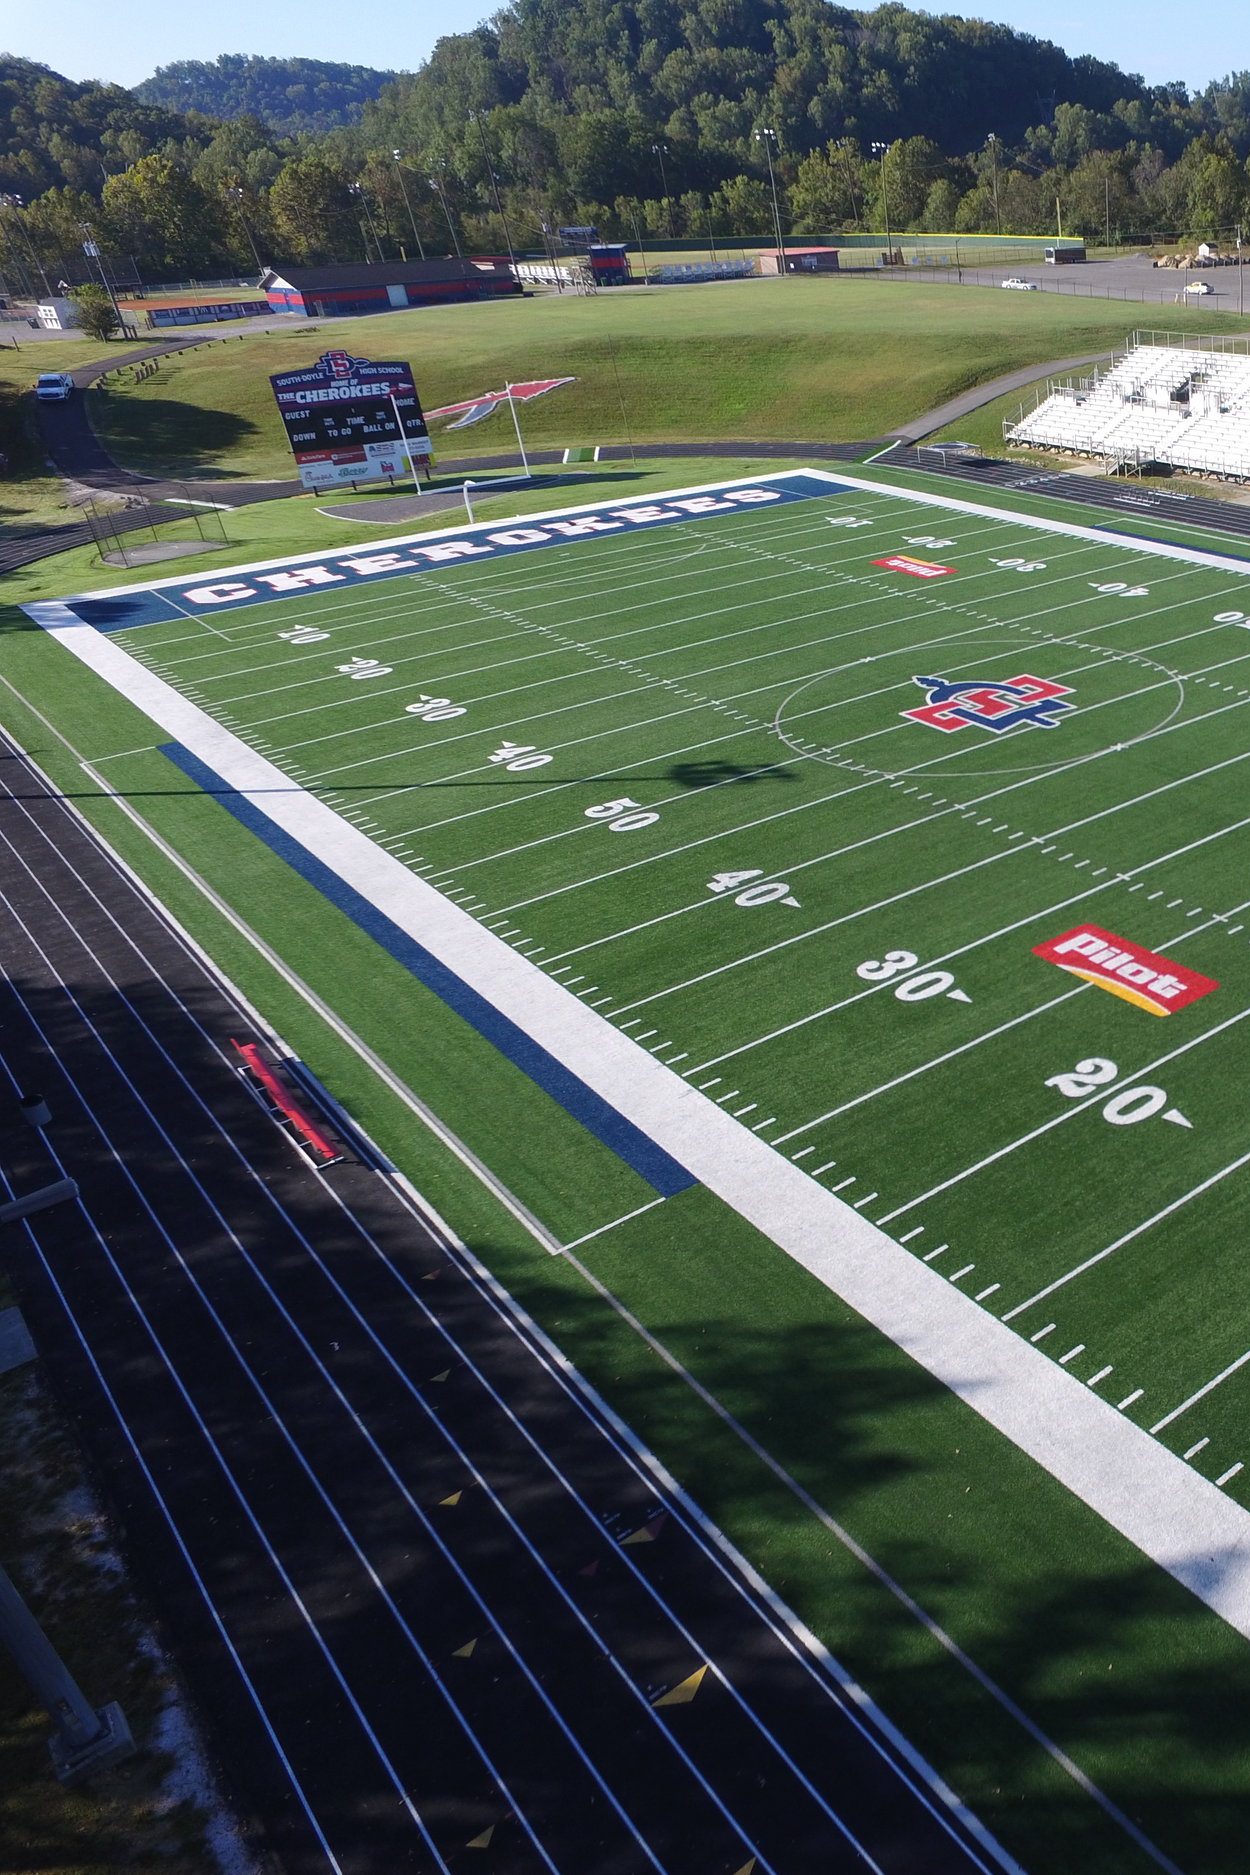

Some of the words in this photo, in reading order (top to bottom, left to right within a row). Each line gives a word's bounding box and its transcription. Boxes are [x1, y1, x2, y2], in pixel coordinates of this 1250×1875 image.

[276, 371, 324, 387] SOUTH-DOYLE
[359, 367, 377, 375] HIGH
[378, 366, 404, 375] SCHOOL
[278, 392, 295, 400] THE
[295, 381, 391, 404] CHEROKEES
[331, 379, 350, 388] HOME
[350, 378, 358, 386] OF
[285, 410, 310, 420] GUEST
[346, 416, 365, 425] TIME
[293, 432, 316, 442] DOWN
[328, 429, 338, 437] TO
[341, 428, 352, 436] GO
[363, 424, 383, 433] BALL
[385, 422, 395, 430] ON
[407, 419, 424, 428] QTR.
[182, 488, 782, 604] CHEROKEES
[908, 535, 957, 549] 20
[997, 557, 1048, 573] 30
[1098, 581, 1150, 598] 40
[277, 626, 331, 644] 10
[334, 659, 393, 680] 20
[405, 698, 467, 722] 30
[487, 745, 554, 772] 40
[584, 797, 660, 832] 50
[706, 869, 790, 907] 40
[856, 950, 955, 1002] 30
[1053, 932, 1188, 999] Pilot
[1044, 1058, 1167, 1126] 20
